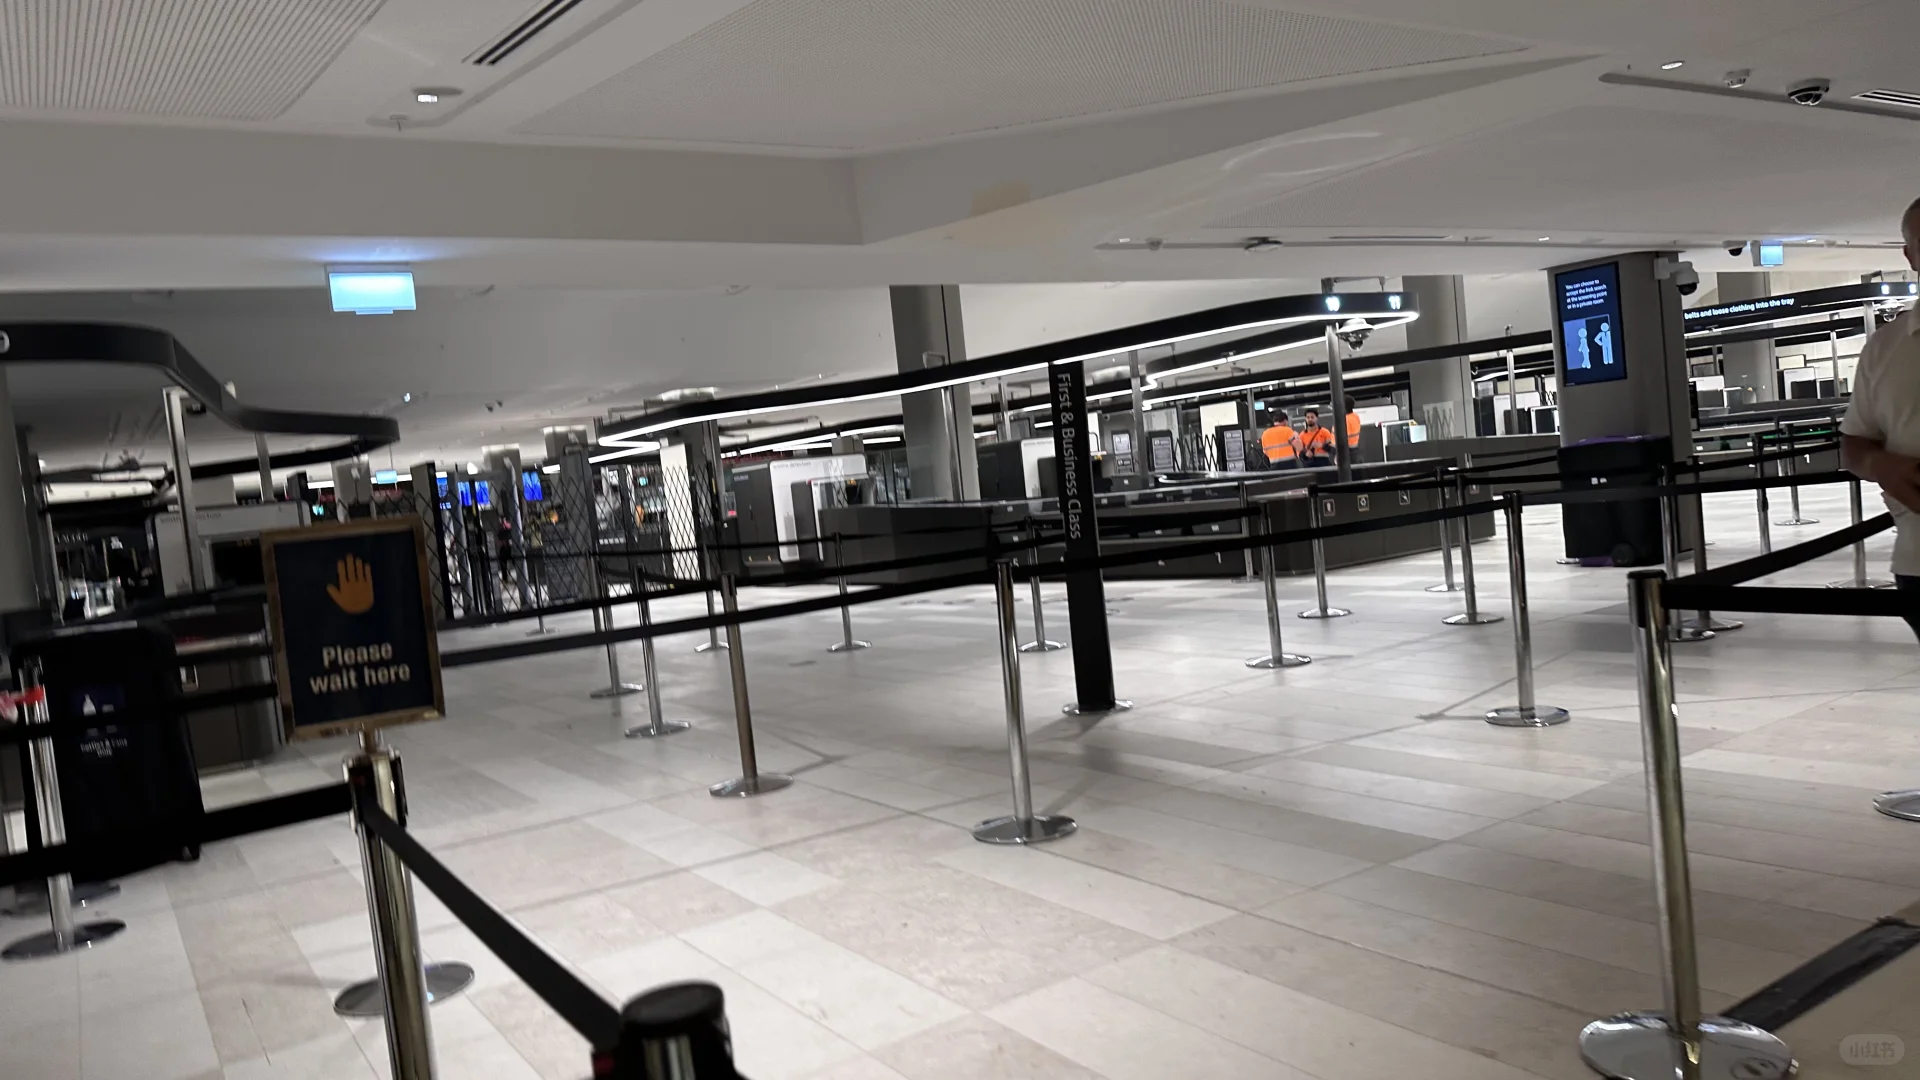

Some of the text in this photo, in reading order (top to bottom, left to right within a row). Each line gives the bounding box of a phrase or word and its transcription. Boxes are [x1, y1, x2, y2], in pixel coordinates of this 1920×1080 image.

[1684, 298, 1795, 320] belts and loose clothing into the tray
[1057, 373, 1082, 540] First & Business Class
[322, 642, 393, 669] Please
[309, 663, 411, 695] wait here
